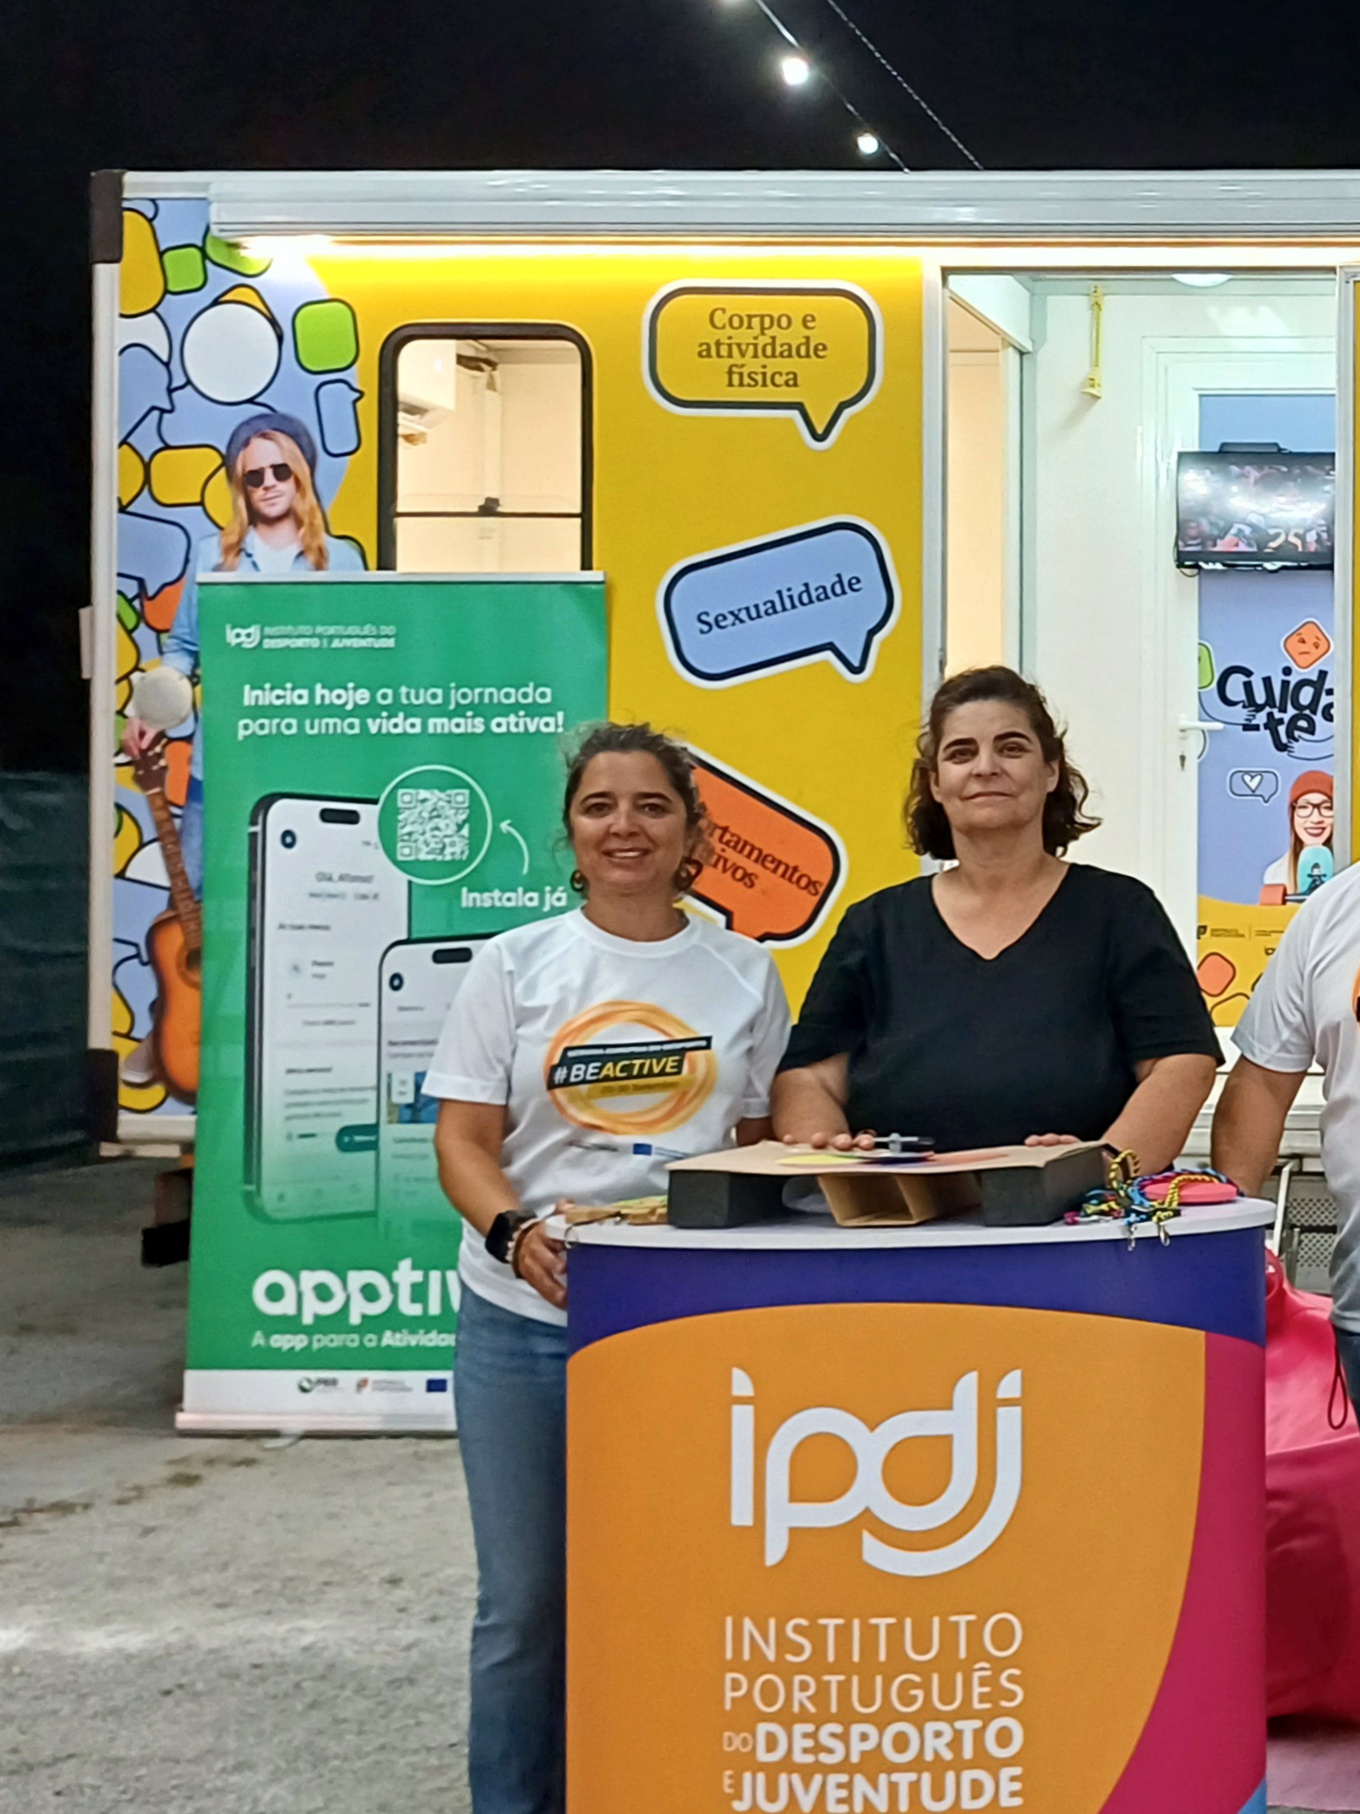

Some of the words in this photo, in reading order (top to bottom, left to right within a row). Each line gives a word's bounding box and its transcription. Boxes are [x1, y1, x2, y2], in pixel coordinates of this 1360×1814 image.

[708, 307, 793, 336] Corpo
[802, 312, 817, 331] e
[697, 335, 829, 360] atividade
[725, 363, 800, 388] física
[696, 573, 864, 635] Sexualidade
[243, 682, 309, 707] Inicia
[314, 682, 371, 711] hoje
[376, 687, 394, 706] a
[399, 685, 444, 705] tua
[447, 682, 552, 711] jornada
[237, 716, 298, 741] para
[305, 717, 361, 735] uma
[367, 711, 422, 735] vida
[427, 711, 485, 734] mais
[490, 710, 565, 734] ativa!
[708, 822, 824, 897] rtamentos
[711, 848, 760, 889] ivos
[461, 886, 539, 908] Instala
[542, 886, 568, 912] já
[554, 1056, 682, 1085] #BEACTIVE
[251, 1330, 266, 1349] A
[269, 1333, 309, 1352] app
[312, 1333, 361, 1352] para
[363, 1333, 379, 1348] a
[730, 1366, 1023, 1577] ipdj
[724, 1612, 1024, 1663] INSTITUTO
[724, 1661, 1025, 1714] PORTUGUÊS
[722, 1731, 753, 1753] DO
[755, 1716, 1025, 1764] DESPORTO
[722, 1769, 735, 1794] E
[731, 1766, 1025, 1814] JUVENTUDE
